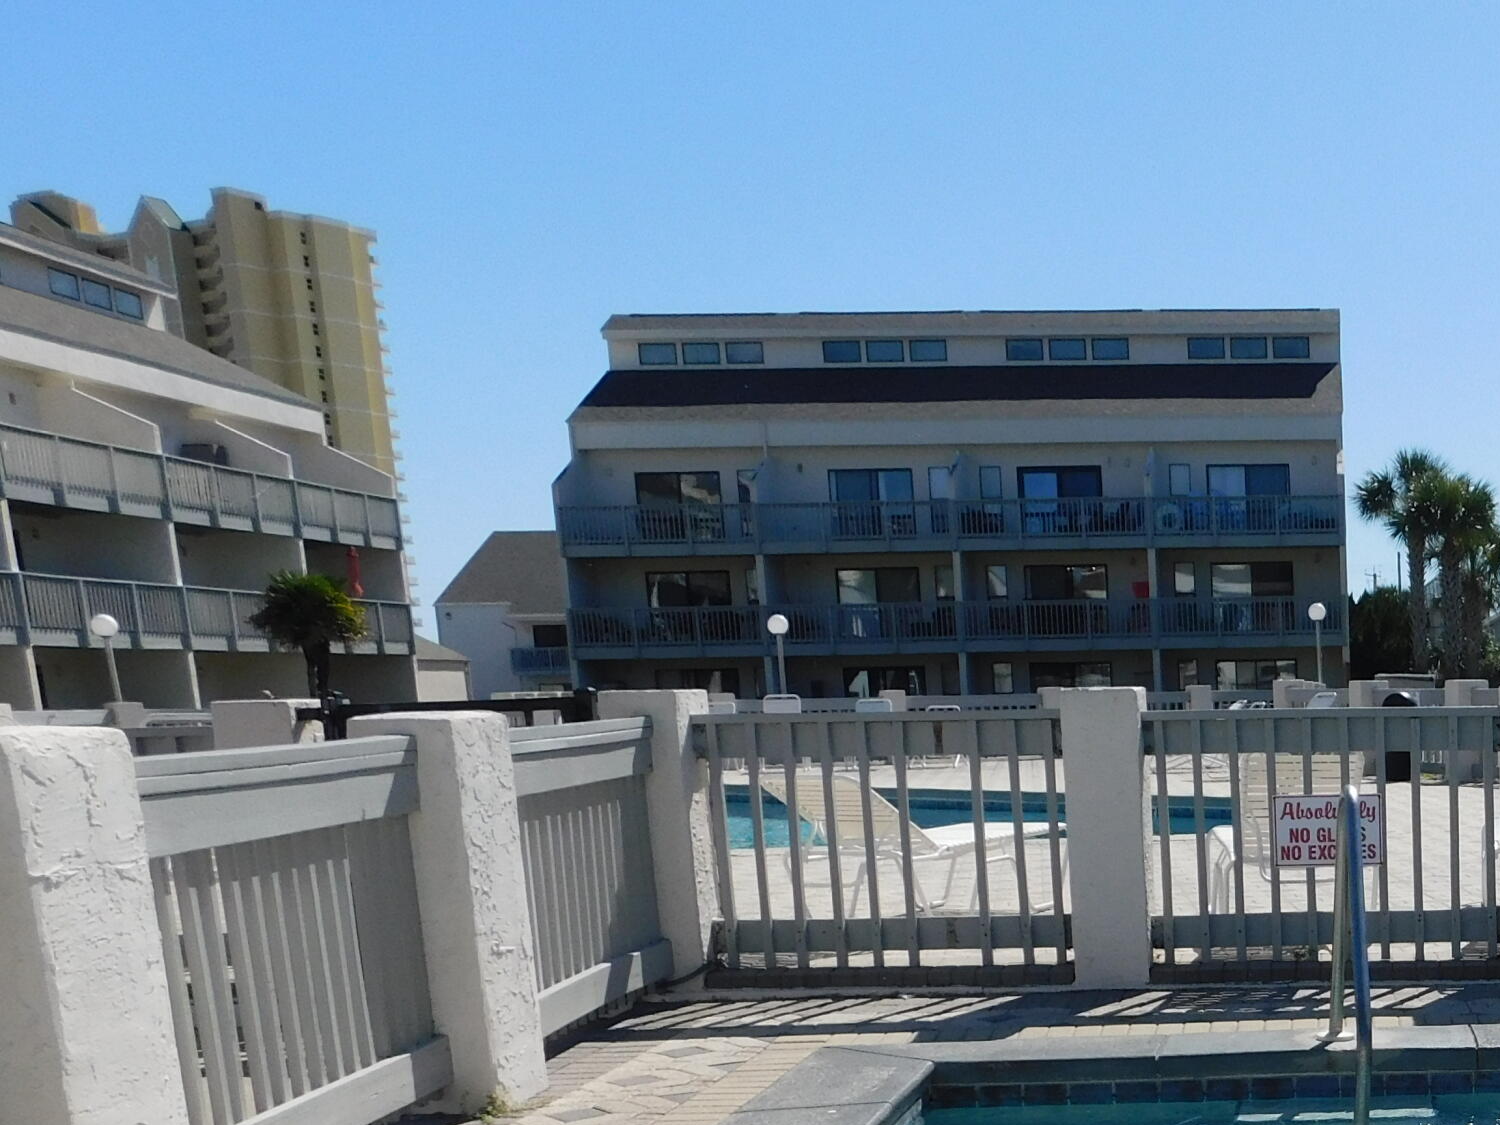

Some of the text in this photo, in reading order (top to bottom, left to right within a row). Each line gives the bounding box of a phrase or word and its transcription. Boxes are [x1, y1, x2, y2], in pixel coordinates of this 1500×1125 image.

[1280, 800, 1376, 823] Absolly
[1289, 827, 1366, 843] NO GLS
[1281, 844, 1376, 860] NO EXCS
